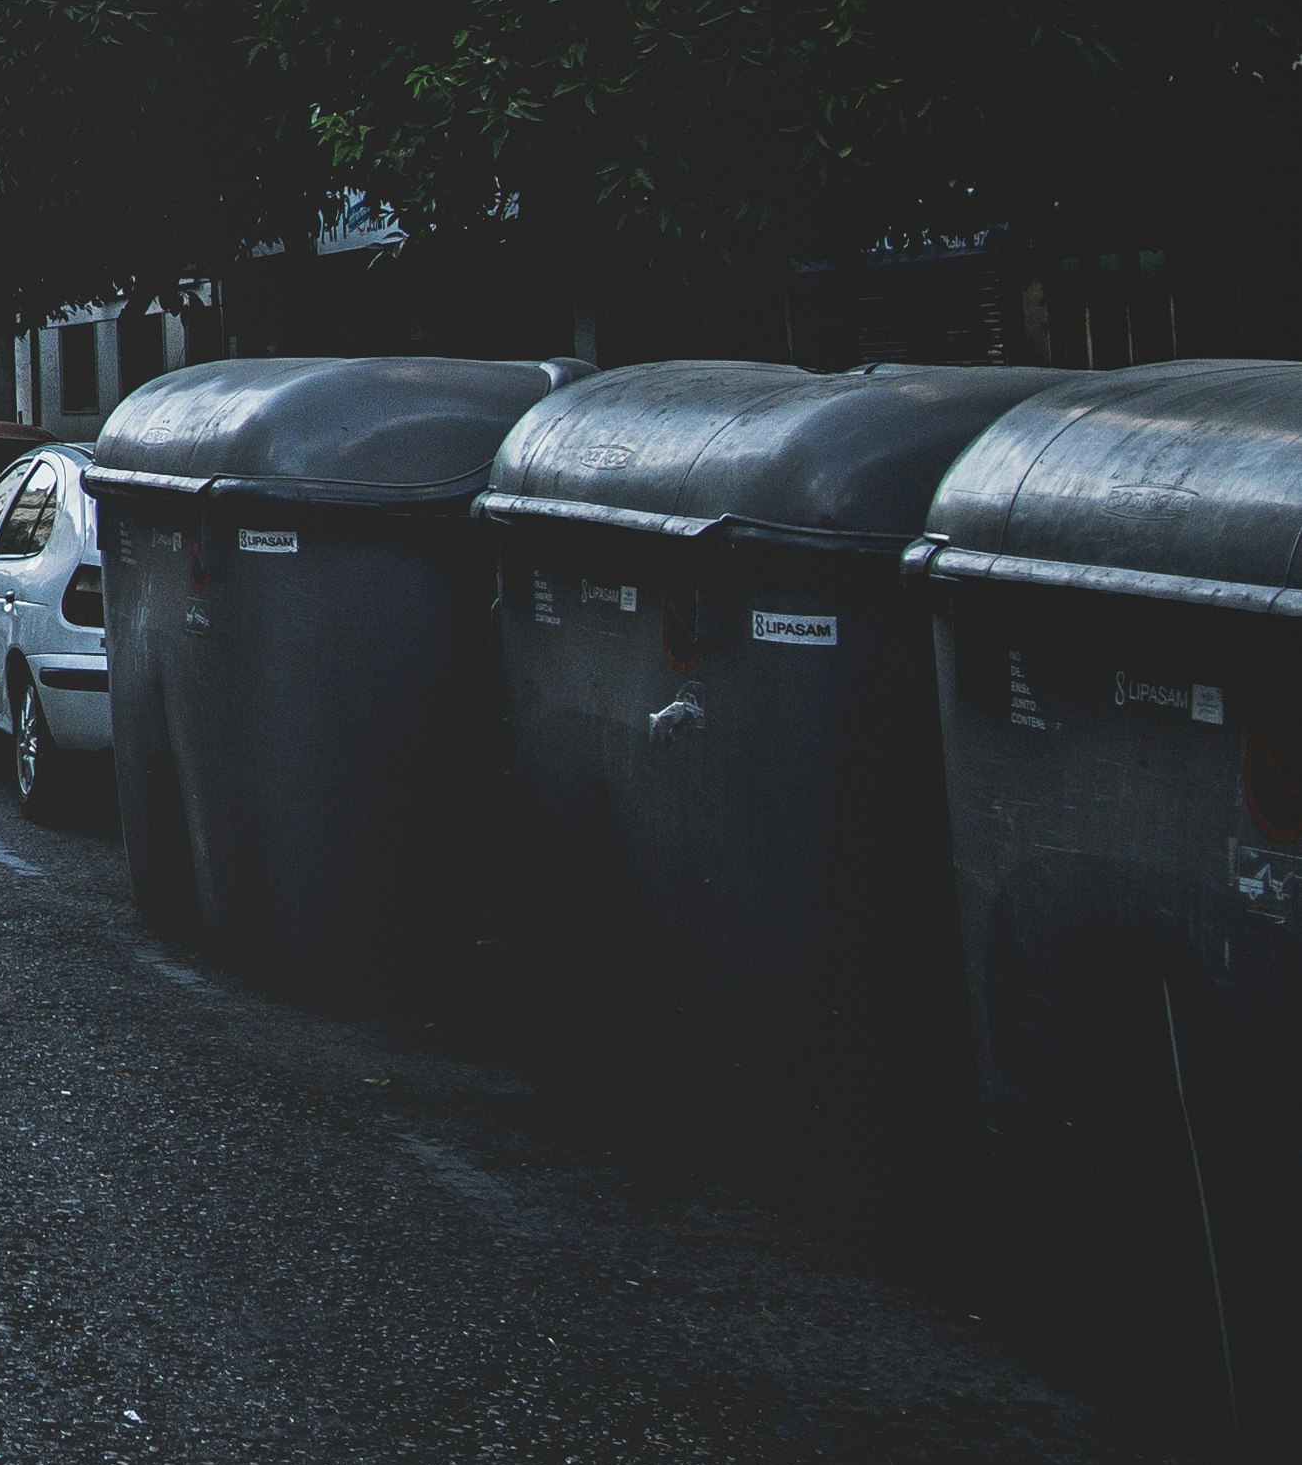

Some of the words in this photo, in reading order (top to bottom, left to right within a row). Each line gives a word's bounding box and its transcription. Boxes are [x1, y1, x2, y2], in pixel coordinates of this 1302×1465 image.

[248, 536, 294, 547] LIPASAM
[766, 620, 831, 637] LIPASAM
[1129, 681, 1188, 710] LIPASAM
